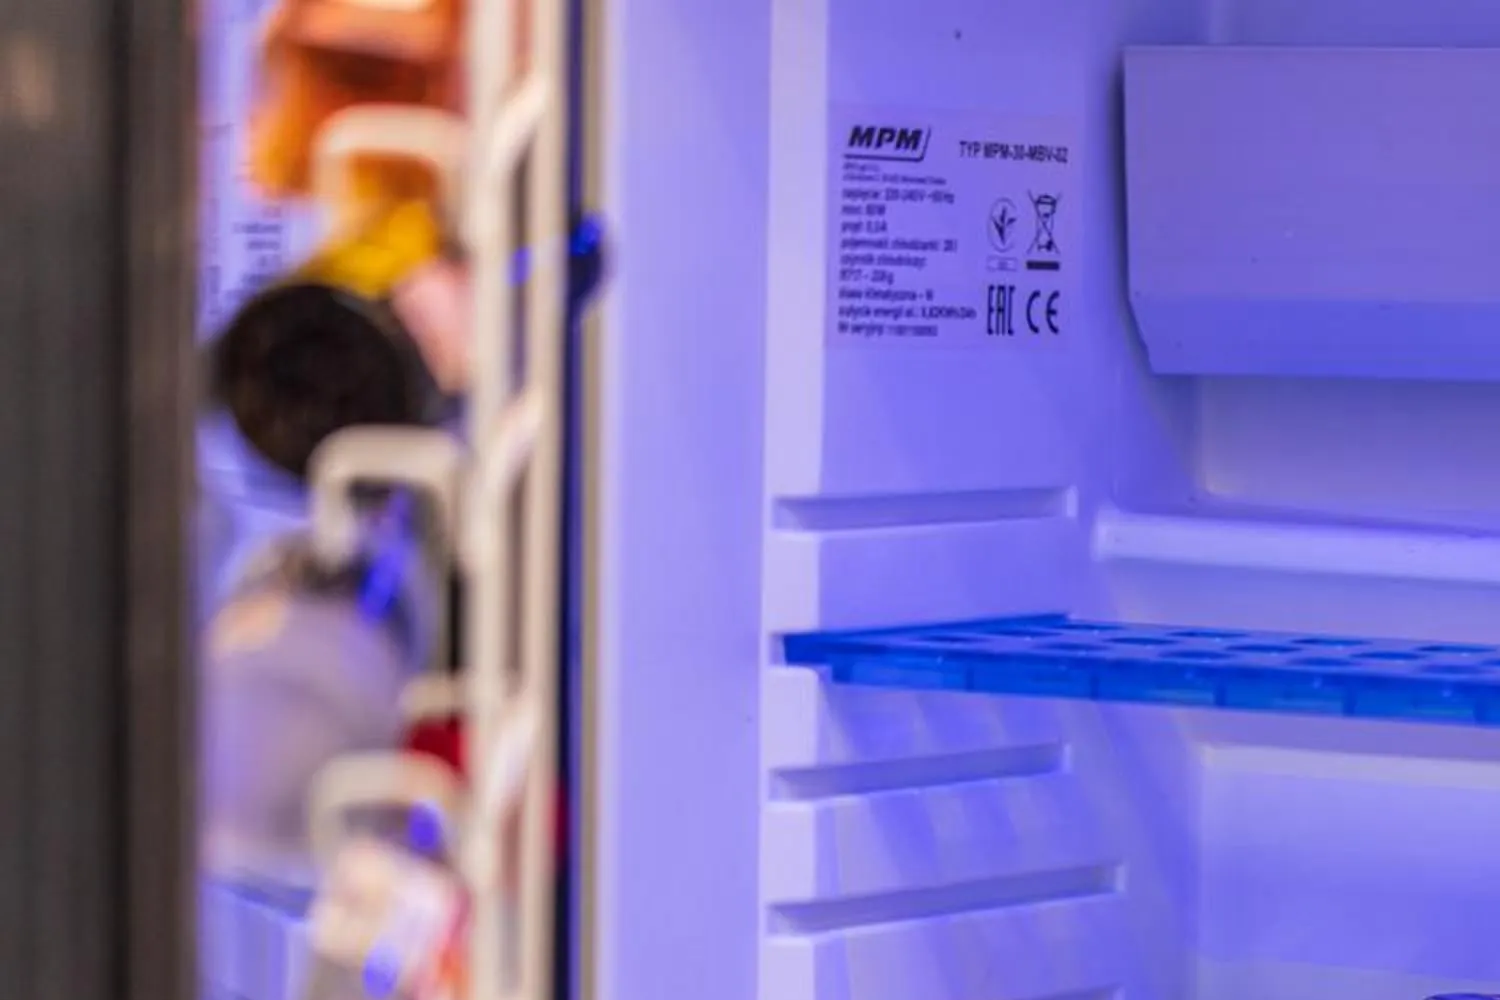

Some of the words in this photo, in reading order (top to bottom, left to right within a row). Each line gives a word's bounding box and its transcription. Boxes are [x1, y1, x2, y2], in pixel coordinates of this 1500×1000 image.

[848, 125, 923, 151] MPM
[959, 140, 981, 158] TYP
[1026, 290, 1060, 334] CE
